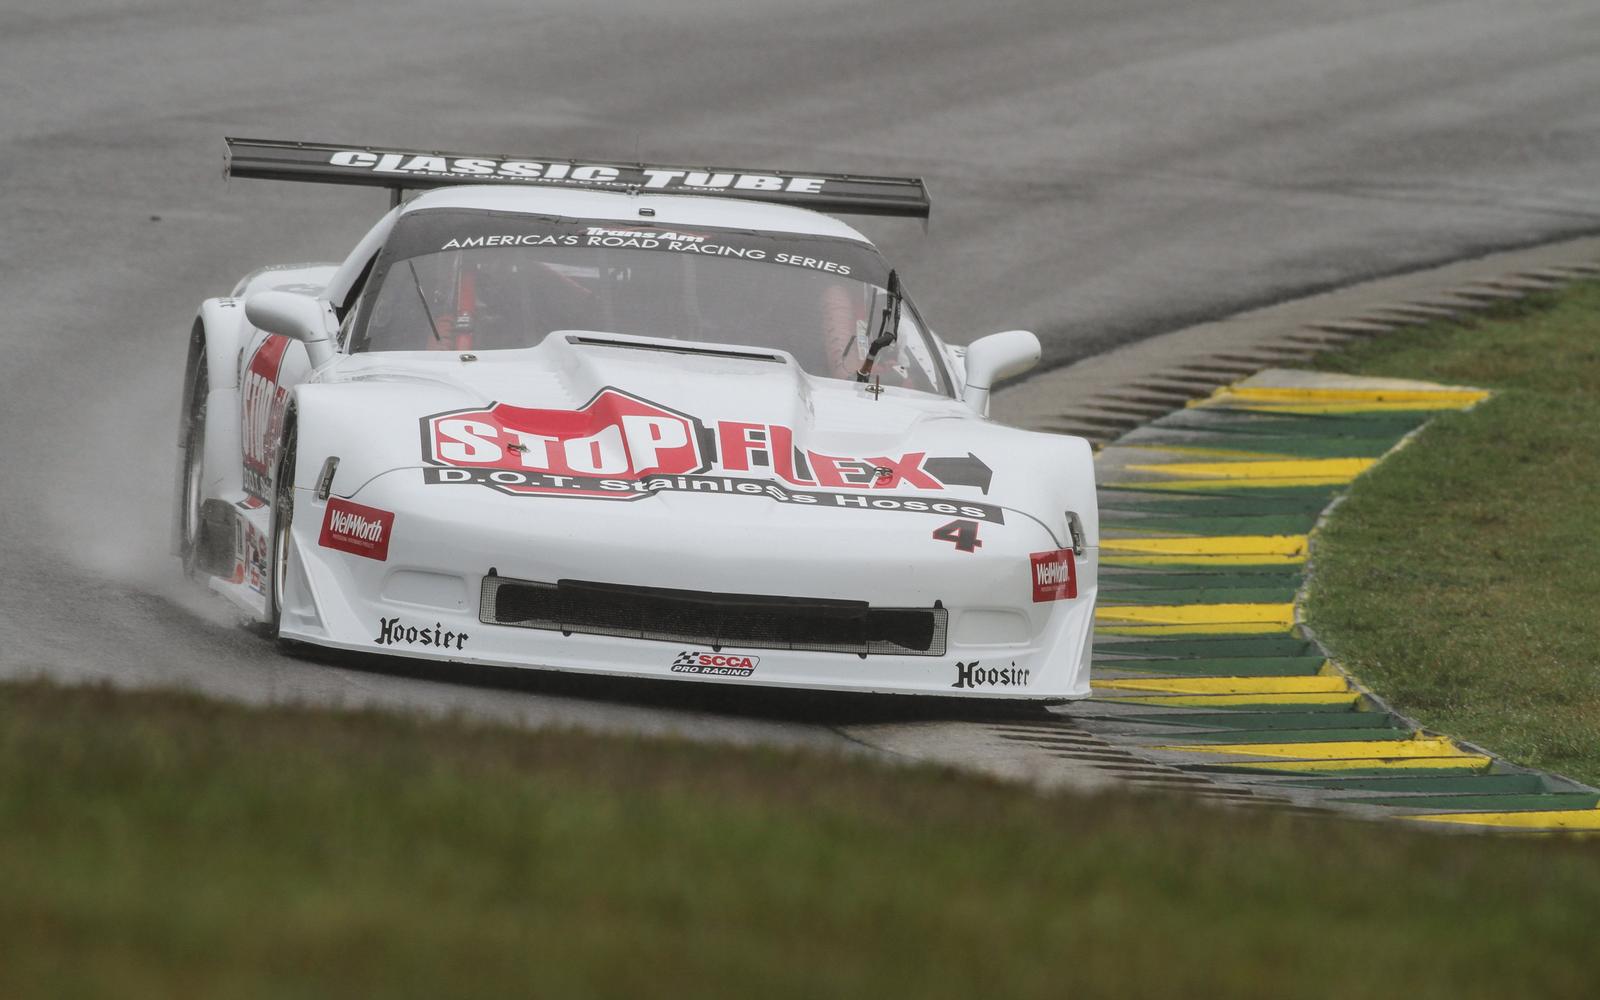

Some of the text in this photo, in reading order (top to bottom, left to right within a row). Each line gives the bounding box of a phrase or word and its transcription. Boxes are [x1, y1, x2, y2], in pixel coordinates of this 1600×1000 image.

[329, 151, 826, 193] CLASSIC TUBE
[441, 235, 851, 275] AMERICA'S ROAD RACING SERIES
[438, 415, 944, 490] STOP FLEX
[438, 469, 987, 518] D.O.T. Stainless Hoses
[932, 518, 983, 553] 4
[374, 616, 469, 651] Hoosier
[672, 664, 751, 676] PRO RACING
[698, 655, 753, 669] SCCA
[951, 660, 1031, 689] Hoosier
